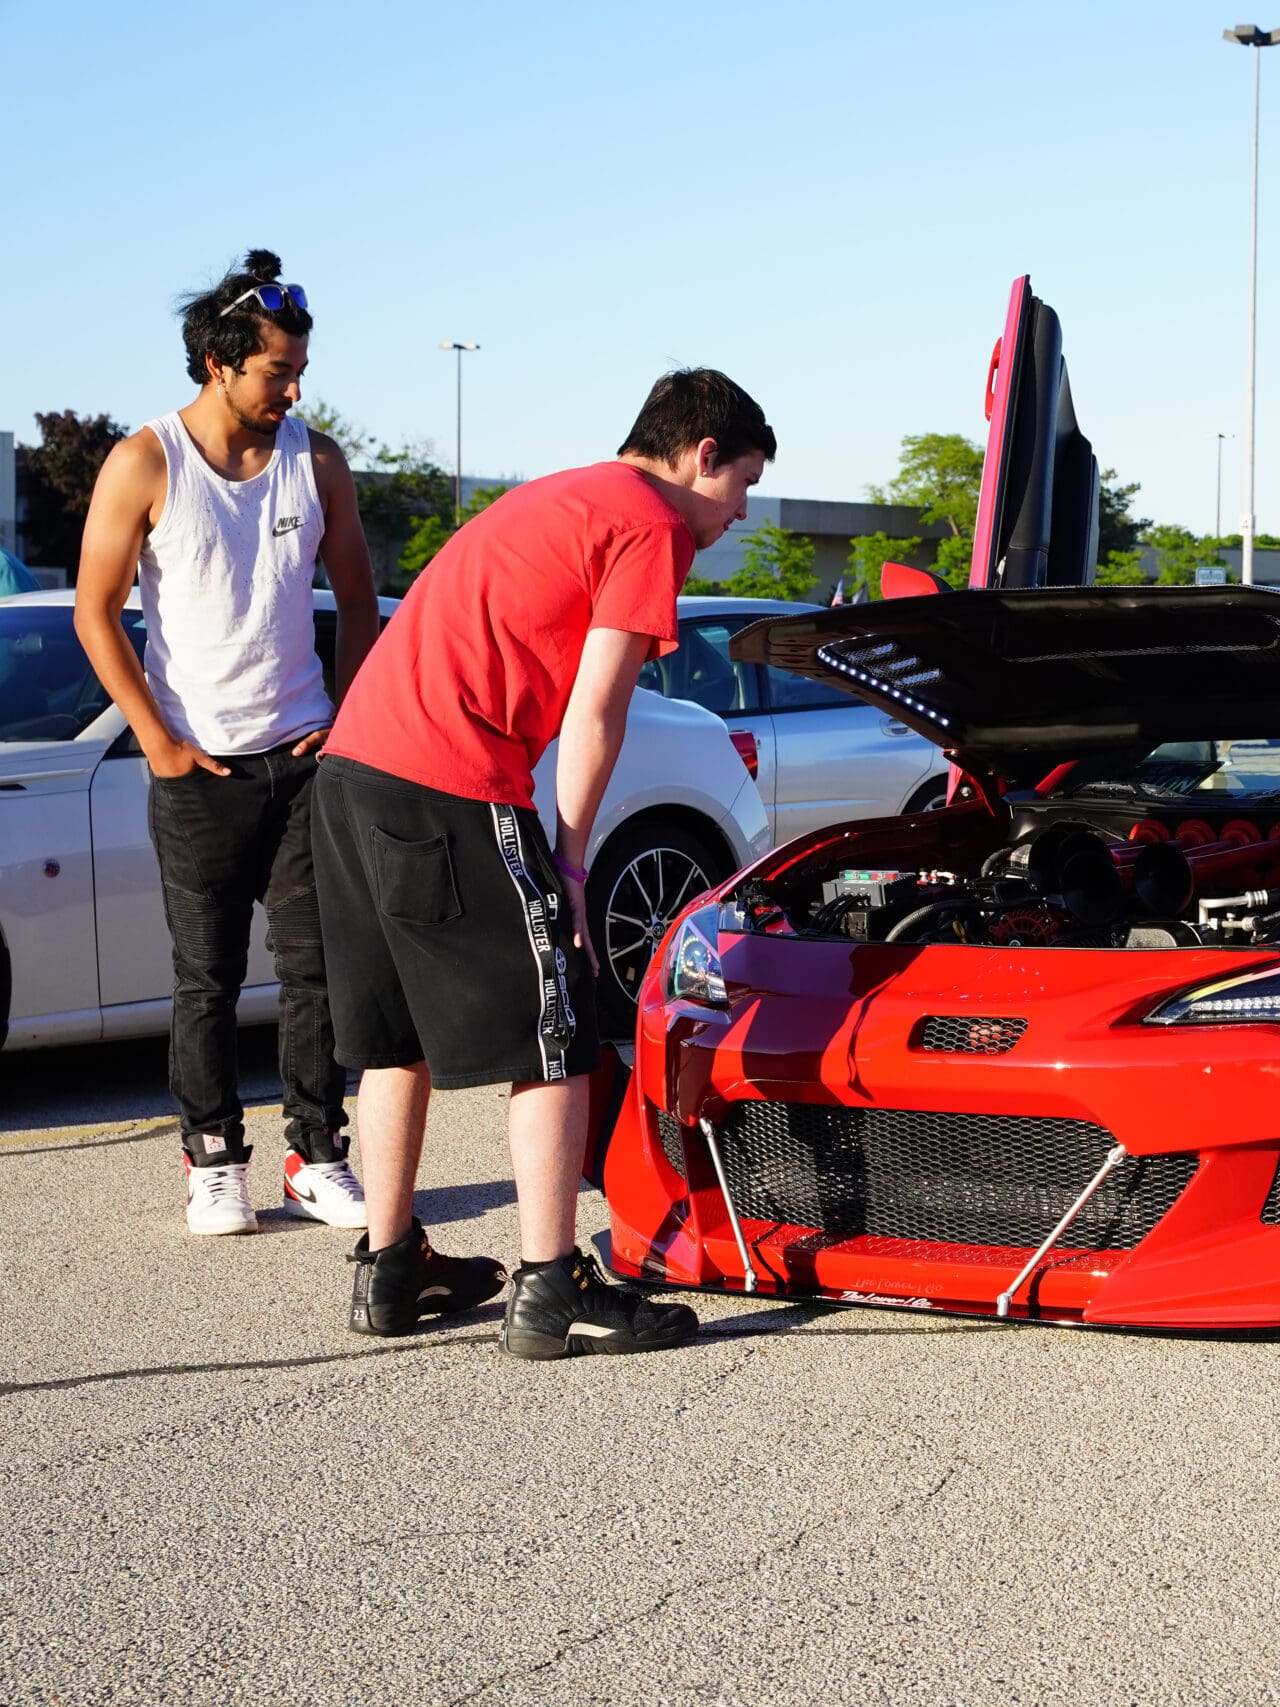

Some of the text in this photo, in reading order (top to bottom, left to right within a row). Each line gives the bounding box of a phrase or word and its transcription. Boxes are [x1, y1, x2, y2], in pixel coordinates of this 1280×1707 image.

[277, 516, 301, 528] NIKE
[499, 816, 523, 877] HOLLISTER
[528, 899, 551, 953] HOLLISTER
[353, 1309, 365, 1321] 23
